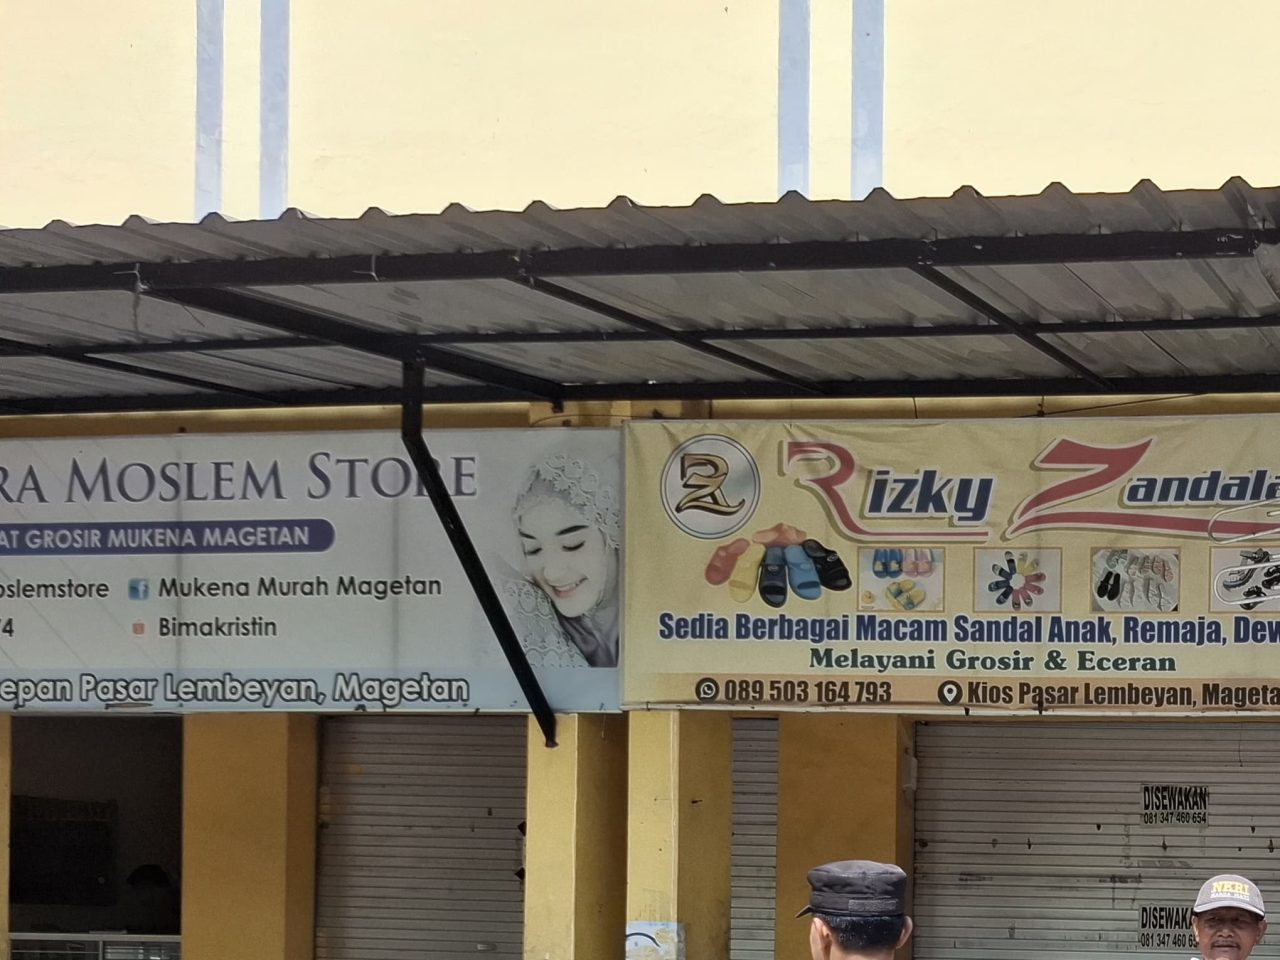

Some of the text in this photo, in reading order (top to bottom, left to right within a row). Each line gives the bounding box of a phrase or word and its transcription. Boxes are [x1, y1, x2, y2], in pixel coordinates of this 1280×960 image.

[64, 456, 287, 503] MOSLEM
[786, 440, 994, 538] Rizky
[25, 529, 101, 549] GROSIR
[108, 527, 195, 547] MUKENA
[203, 525, 310, 546] MAGETAN
[159, 576, 442, 602] Mukena Murah Magetan
[159, 616, 277, 638] Bimakristin
[659, 613, 729, 641] Sedia
[735, 614, 850, 643] Berbagai
[855, 615, 948, 641] Macam
[953, 615, 1042, 643] Sandal
[1048, 616, 1117, 646] Anak,
[1124, 617, 1228, 647] Remaja,
[809, 648, 1177, 673] Melayani Grosir & Eceran
[80, 673, 158, 702] Pasar
[164, 672, 326, 705] Lembeyan,
[332, 674, 470, 704] Magetan
[724, 681, 892, 702] 089 503 164 793
[967, 682, 1013, 704] Kios
[1018, 682, 1079, 705] Pasar
[1085, 683, 1197, 708] Lembeyan,
[1143, 785, 1208, 811] DISEWAKAN
[1143, 811, 1207, 825] 081 347 460 654
[1140, 932, 1154, 947] 081
[1157, 932, 1171, 947] 347
[1172, 933, 1187, 948] 460
